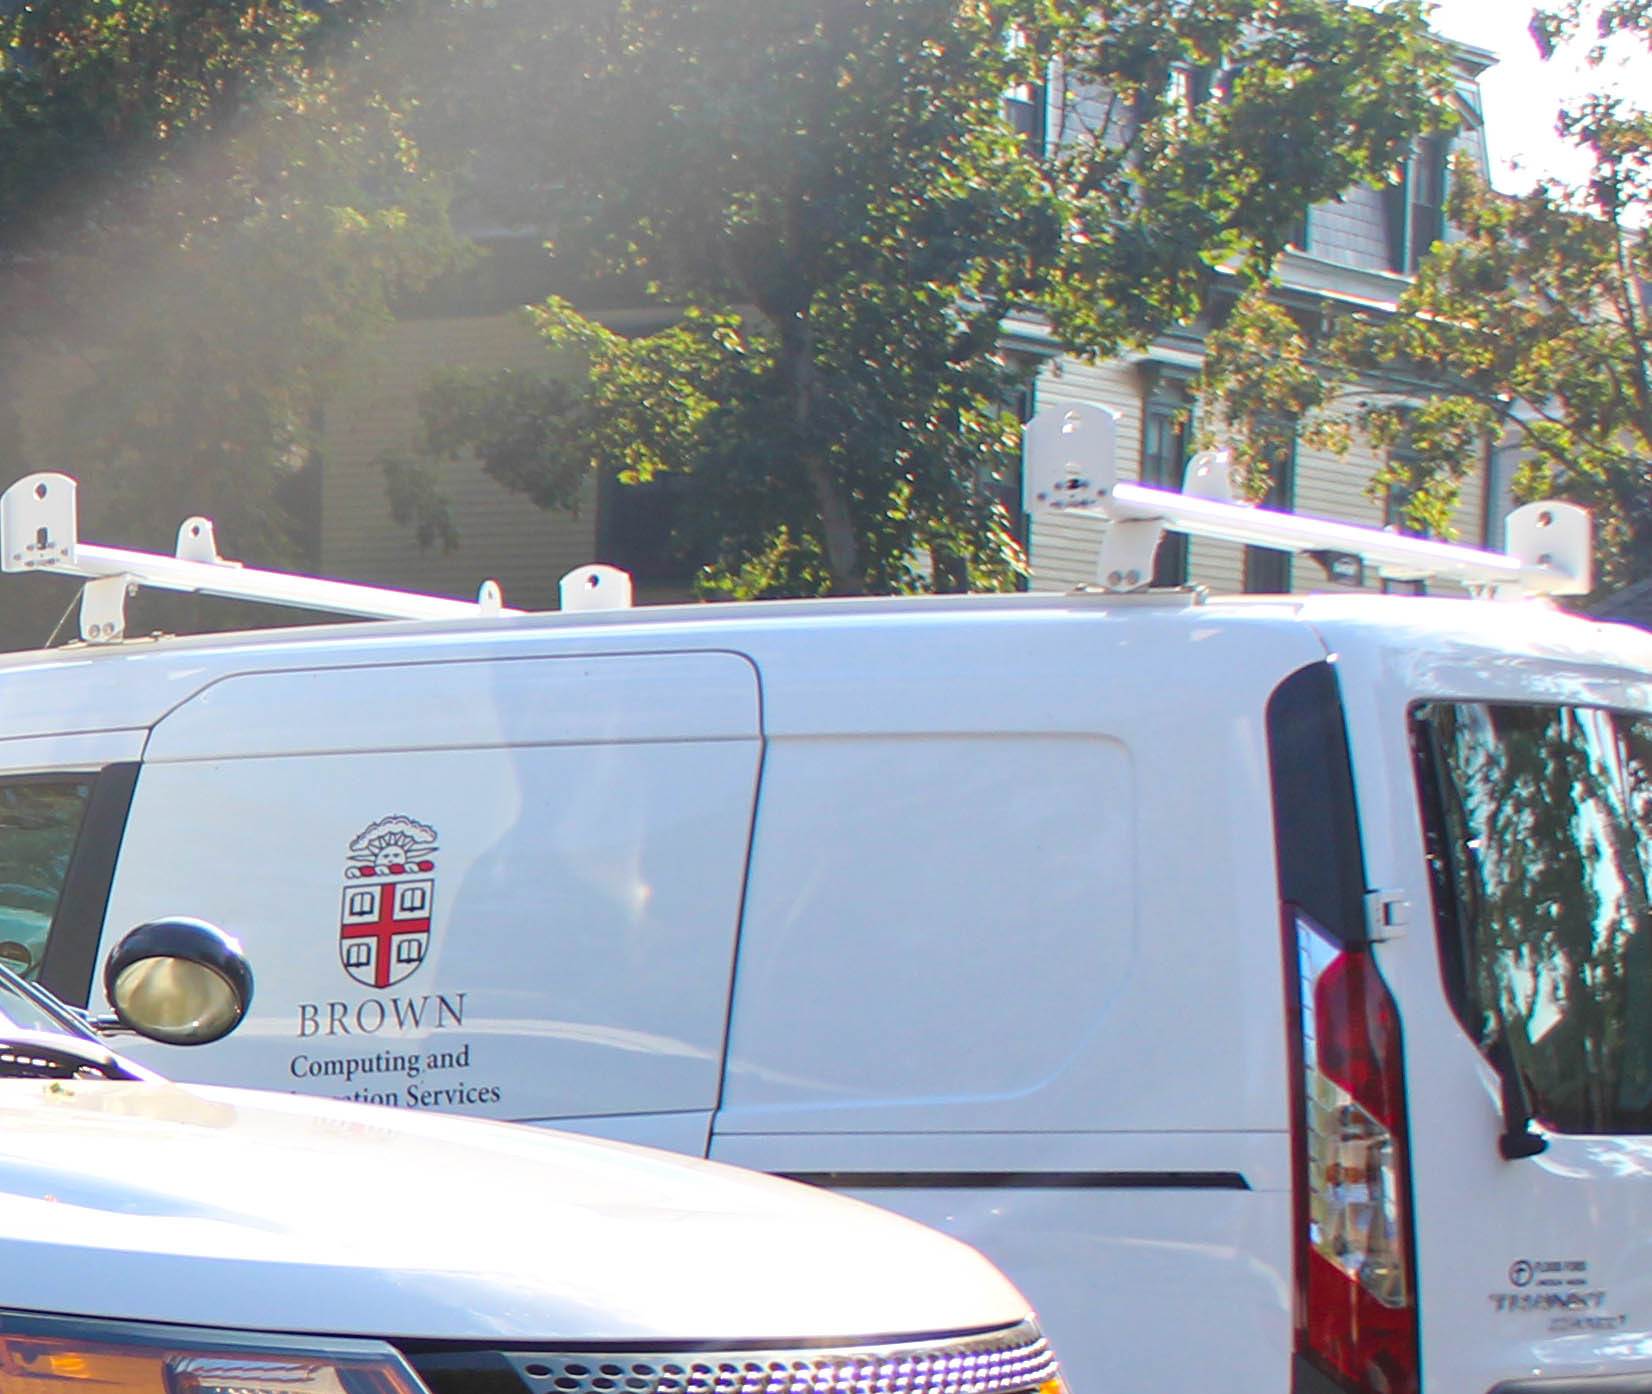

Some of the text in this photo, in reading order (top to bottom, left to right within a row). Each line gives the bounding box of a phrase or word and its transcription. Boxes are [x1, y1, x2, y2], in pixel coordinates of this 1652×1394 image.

[297, 993, 467, 1037] BROWN
[290, 1044, 470, 1081] Computing and
[406, 1082, 501, 1108] Services
